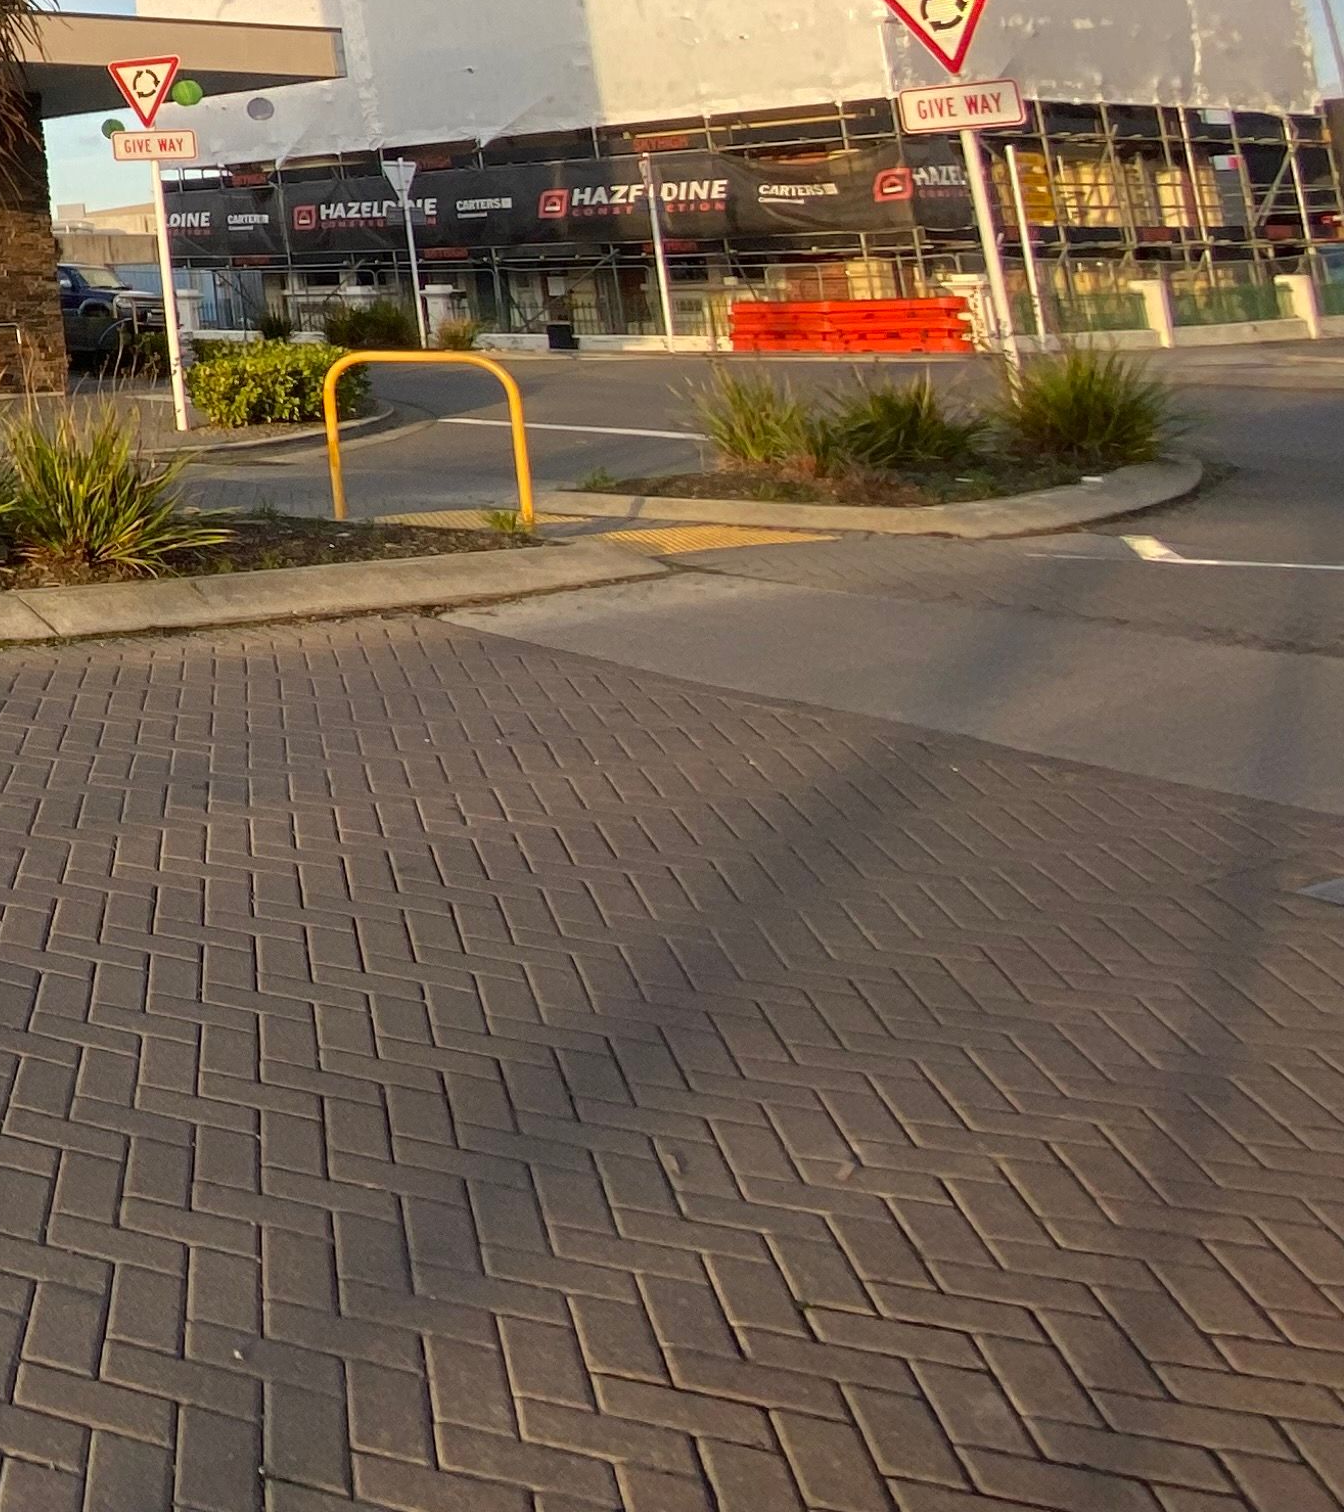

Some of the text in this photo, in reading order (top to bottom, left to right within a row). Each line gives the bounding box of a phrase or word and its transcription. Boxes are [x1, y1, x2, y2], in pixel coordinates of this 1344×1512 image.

[917, 92, 1002, 120] GIVE WAY
[124, 138, 184, 153] GIVE WAY
[912, 165, 968, 186] HAZEL
[571, 179, 729, 206] HAZEDINE
[758, 183, 825, 196] CARTERS
[320, 198, 438, 220] HAZELDE
[456, 199, 501, 211] CARTERS
[571, 201, 727, 216] CONSTCTION
[167, 212, 211, 228] DINE
